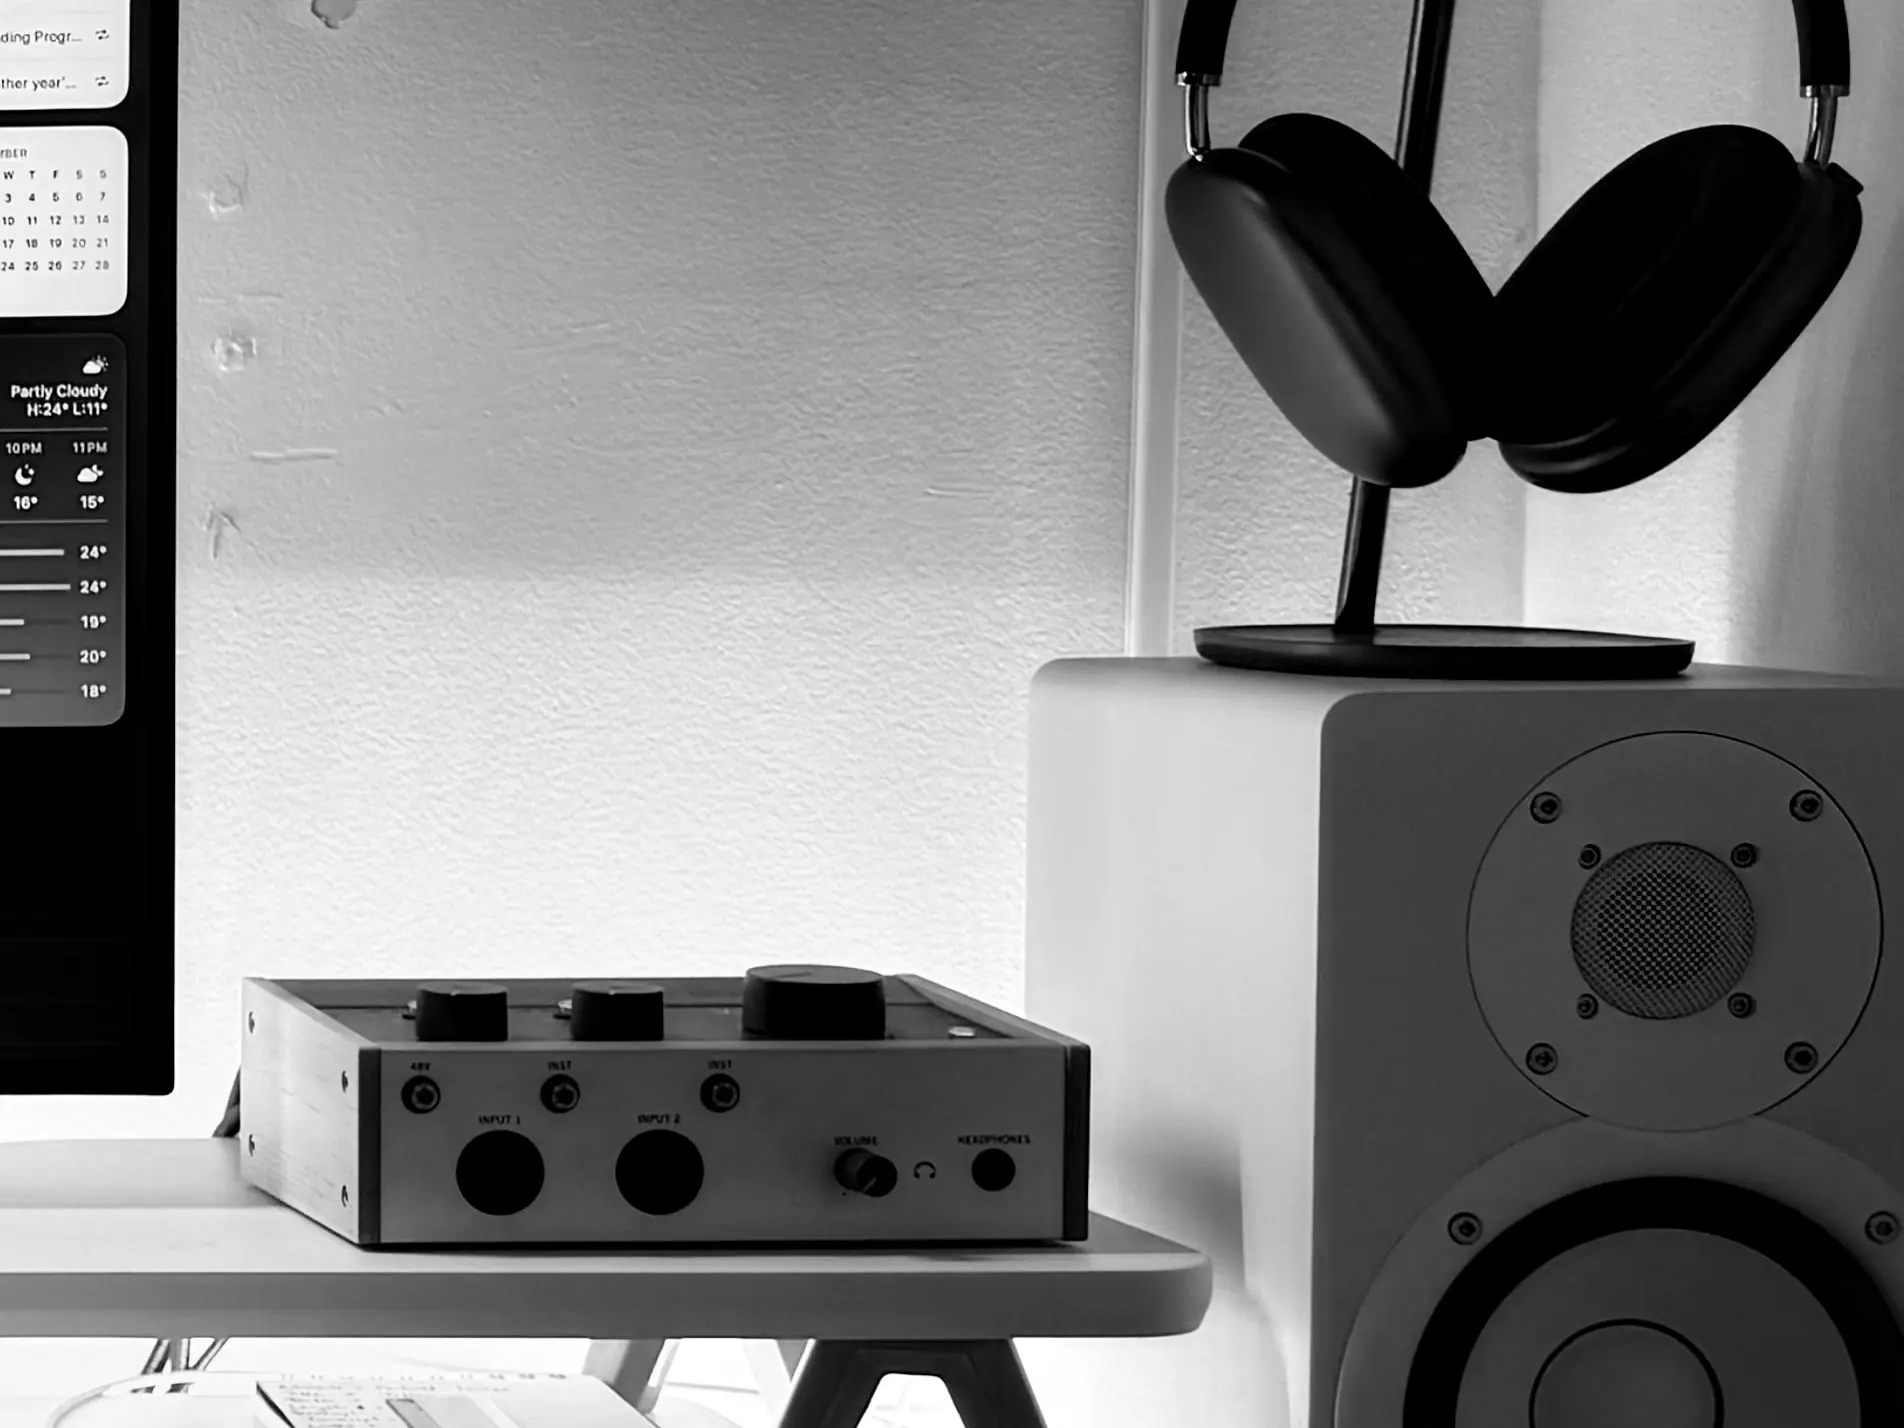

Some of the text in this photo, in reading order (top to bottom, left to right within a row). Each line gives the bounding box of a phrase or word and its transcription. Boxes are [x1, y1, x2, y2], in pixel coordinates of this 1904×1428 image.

[10, 383, 108, 400] Partly Cloudy
[547, 1060, 572, 1071] INST
[707, 1060, 733, 1070] INST
[478, 1115, 513, 1125] INPUT
[637, 1114, 671, 1124] INPUT
[833, 1136, 879, 1146] VOLUME
[957, 1134, 1032, 1145] HEADPHONES
